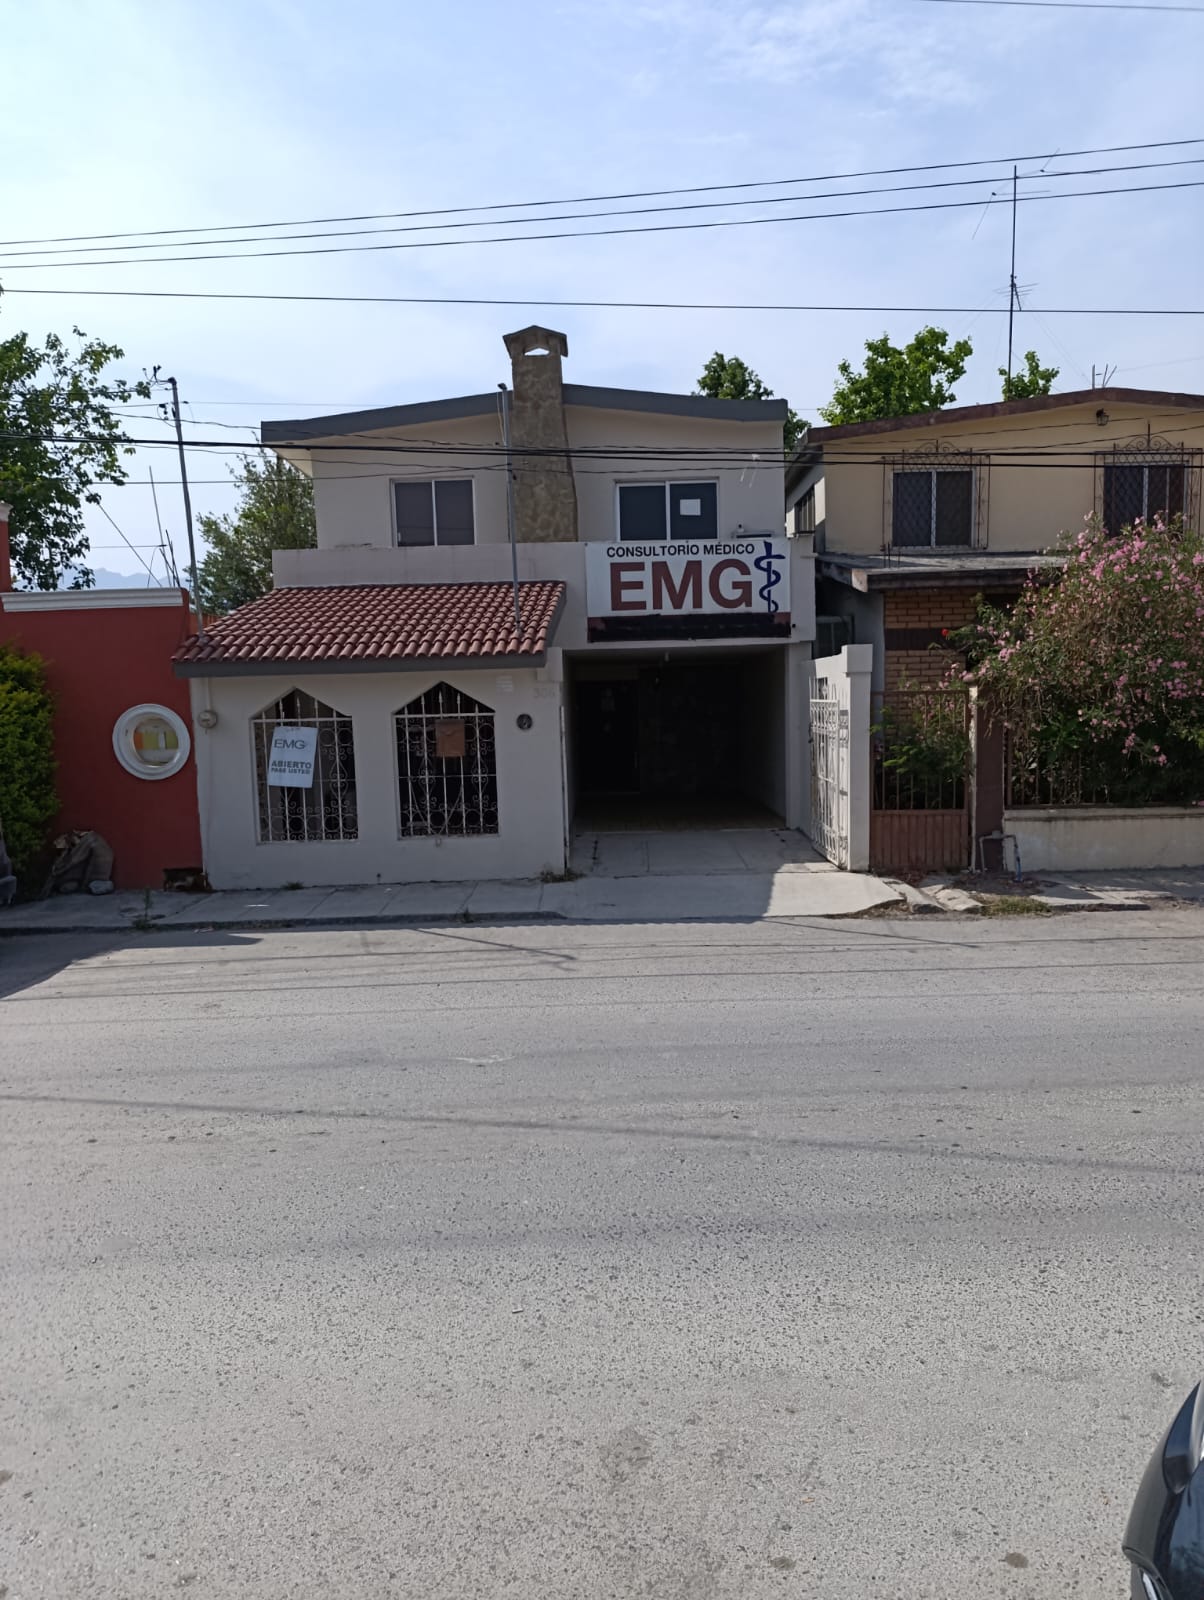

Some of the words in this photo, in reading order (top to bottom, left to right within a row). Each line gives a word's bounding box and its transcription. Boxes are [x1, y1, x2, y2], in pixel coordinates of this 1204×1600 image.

[610, 558, 753, 611] EMG
[274, 738, 306, 750] EMG
[271, 760, 312, 769] ABIERTO
